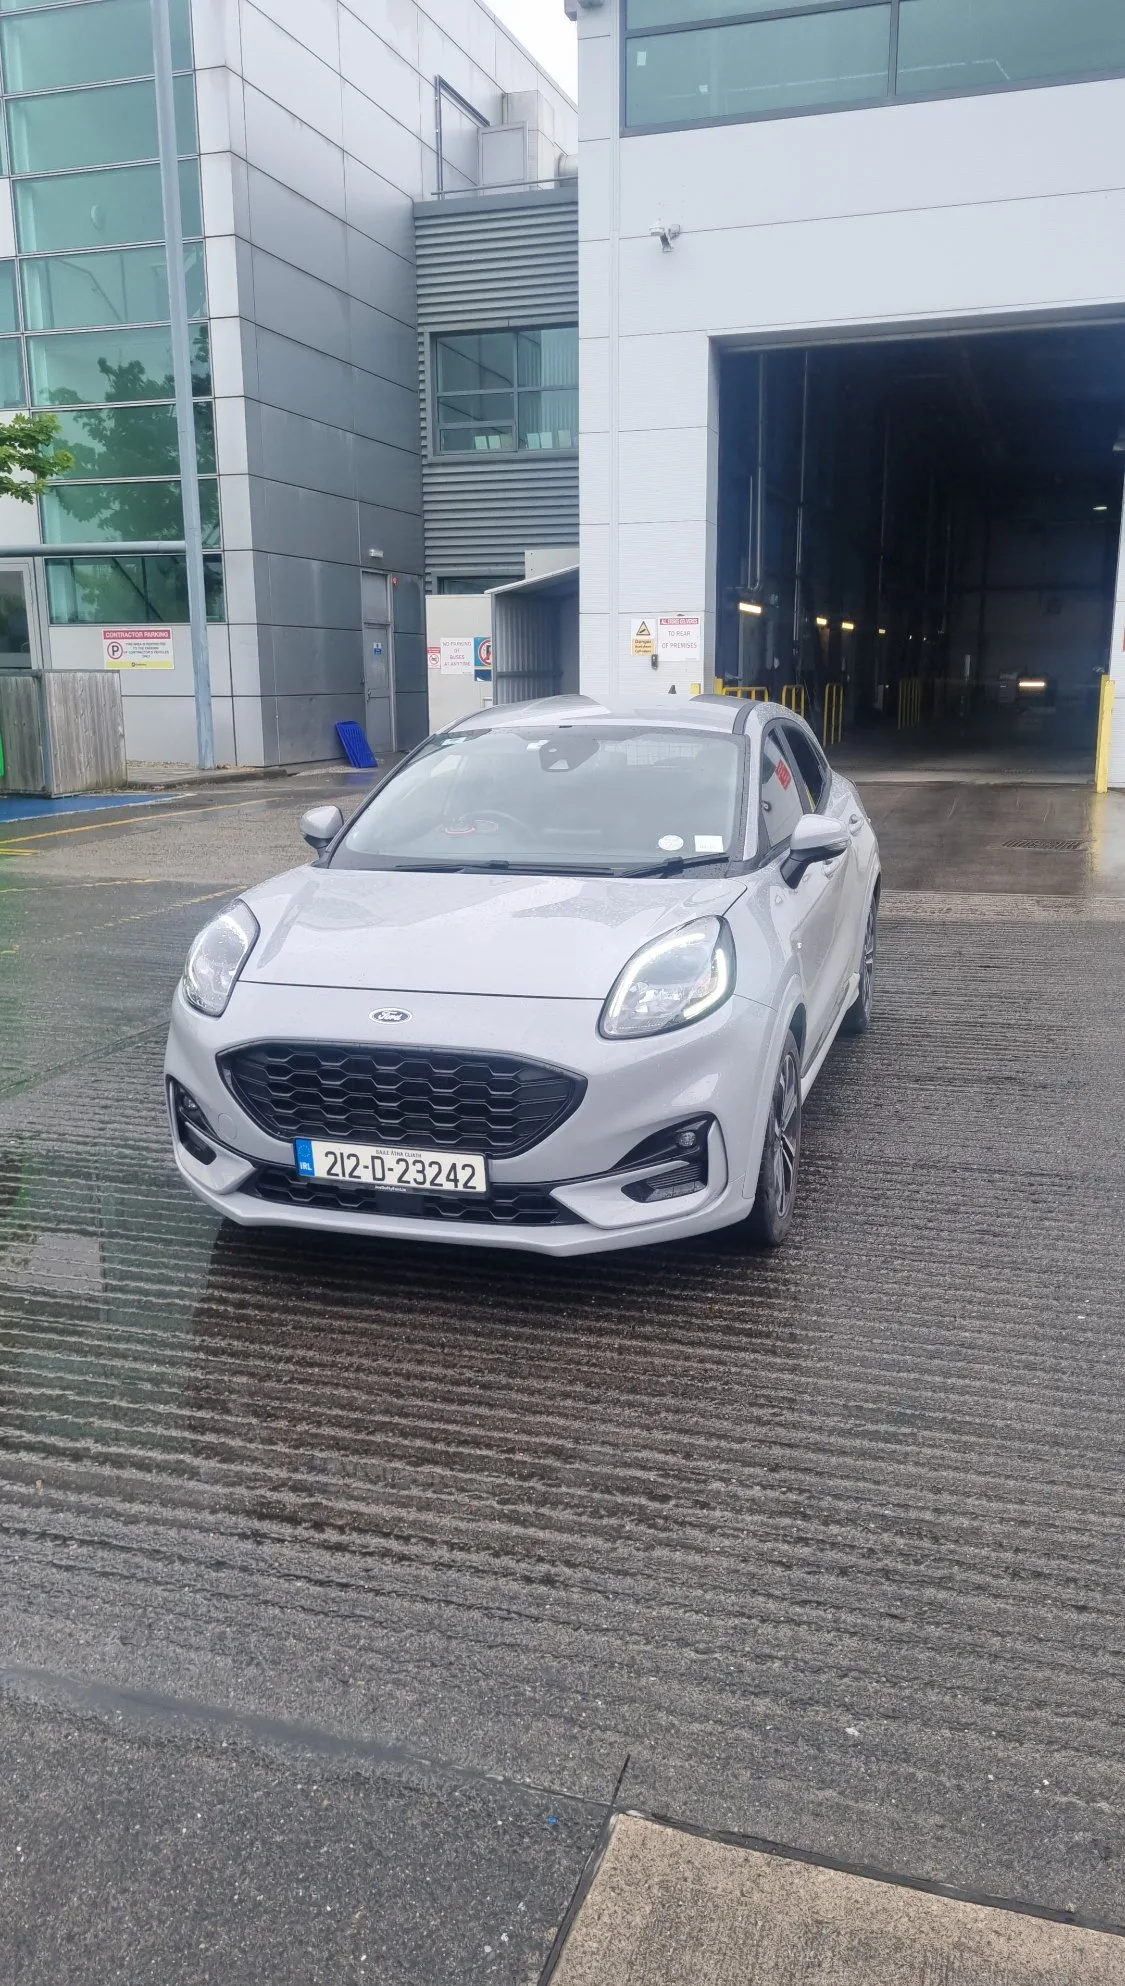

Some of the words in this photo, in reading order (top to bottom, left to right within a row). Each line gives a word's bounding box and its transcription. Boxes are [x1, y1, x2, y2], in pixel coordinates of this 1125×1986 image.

[377, 1011, 403, 1021] Ford
[300, 1162, 312, 1171] IRL
[324, 1150, 477, 1190] 212-D-23242
